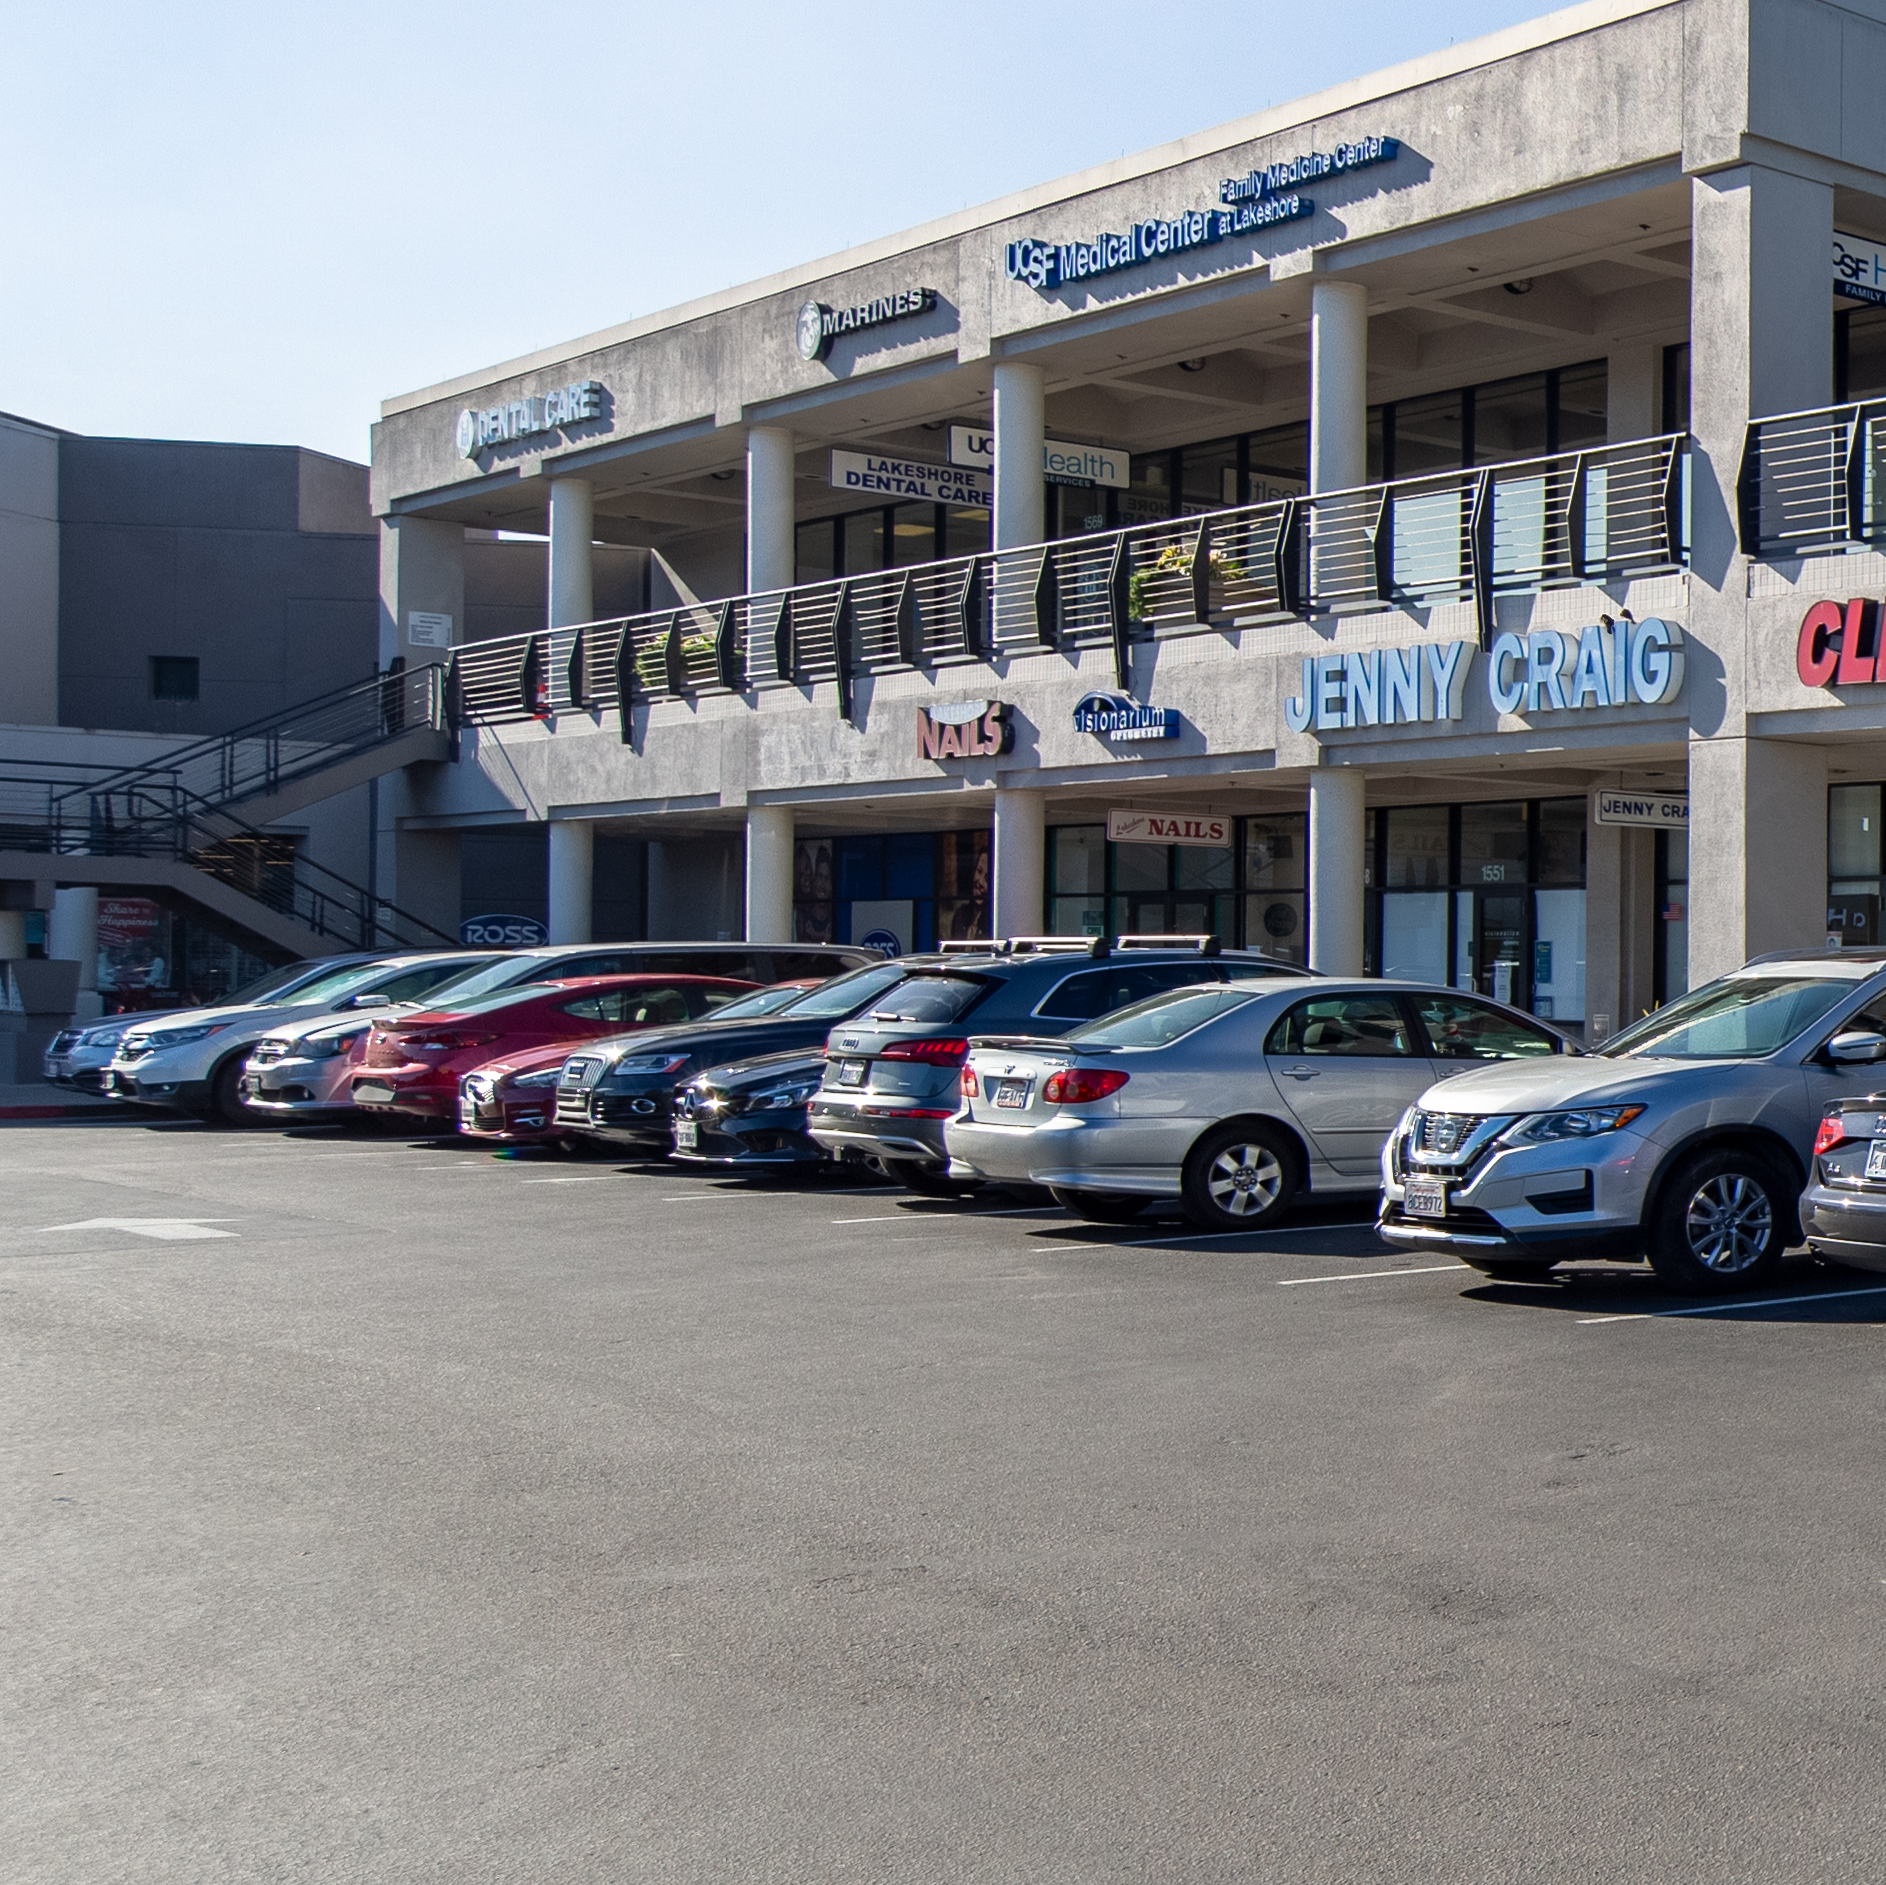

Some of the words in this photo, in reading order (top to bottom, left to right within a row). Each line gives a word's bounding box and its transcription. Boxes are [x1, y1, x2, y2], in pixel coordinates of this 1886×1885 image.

[1219, 172, 1263, 204] Family
[1266, 152, 1331, 190] Medicine
[1335, 135, 1387, 168] Center
[1217, 214, 1232, 236] at
[1233, 193, 1300, 233] Lakeshore
[1004, 237, 1054, 289] UCSF
[1059, 224, 1136, 282] Medical
[1139, 209, 1213, 256] Center
[1845, 284, 1882, 303] FAMILY
[822, 287, 924, 337] MARINES
[477, 396, 543, 446] DENTAL
[544, 379, 595, 428] CARE
[866, 457, 976, 488] LAKESHORE
[967, 434, 993, 455] UC
[1043, 446, 1115, 480] ealth
[845, 470, 933, 498] DENTAL
[937, 484, 993, 506] CARE
[1083, 514, 1103, 530] 1569
[1284, 640, 1470, 734] JENNY
[1488, 617, 1680, 715] CRAIG
[916, 702, 1001, 760] NAILS
[1072, 707, 1166, 733] visionarium
[1602, 797, 1655, 816] JENNY
[1661, 802, 1689, 820] CRA
[1147, 818, 1224, 840] NAILS
[1481, 865, 1505, 881] 1551
[466, 925, 539, 944] ROSS
